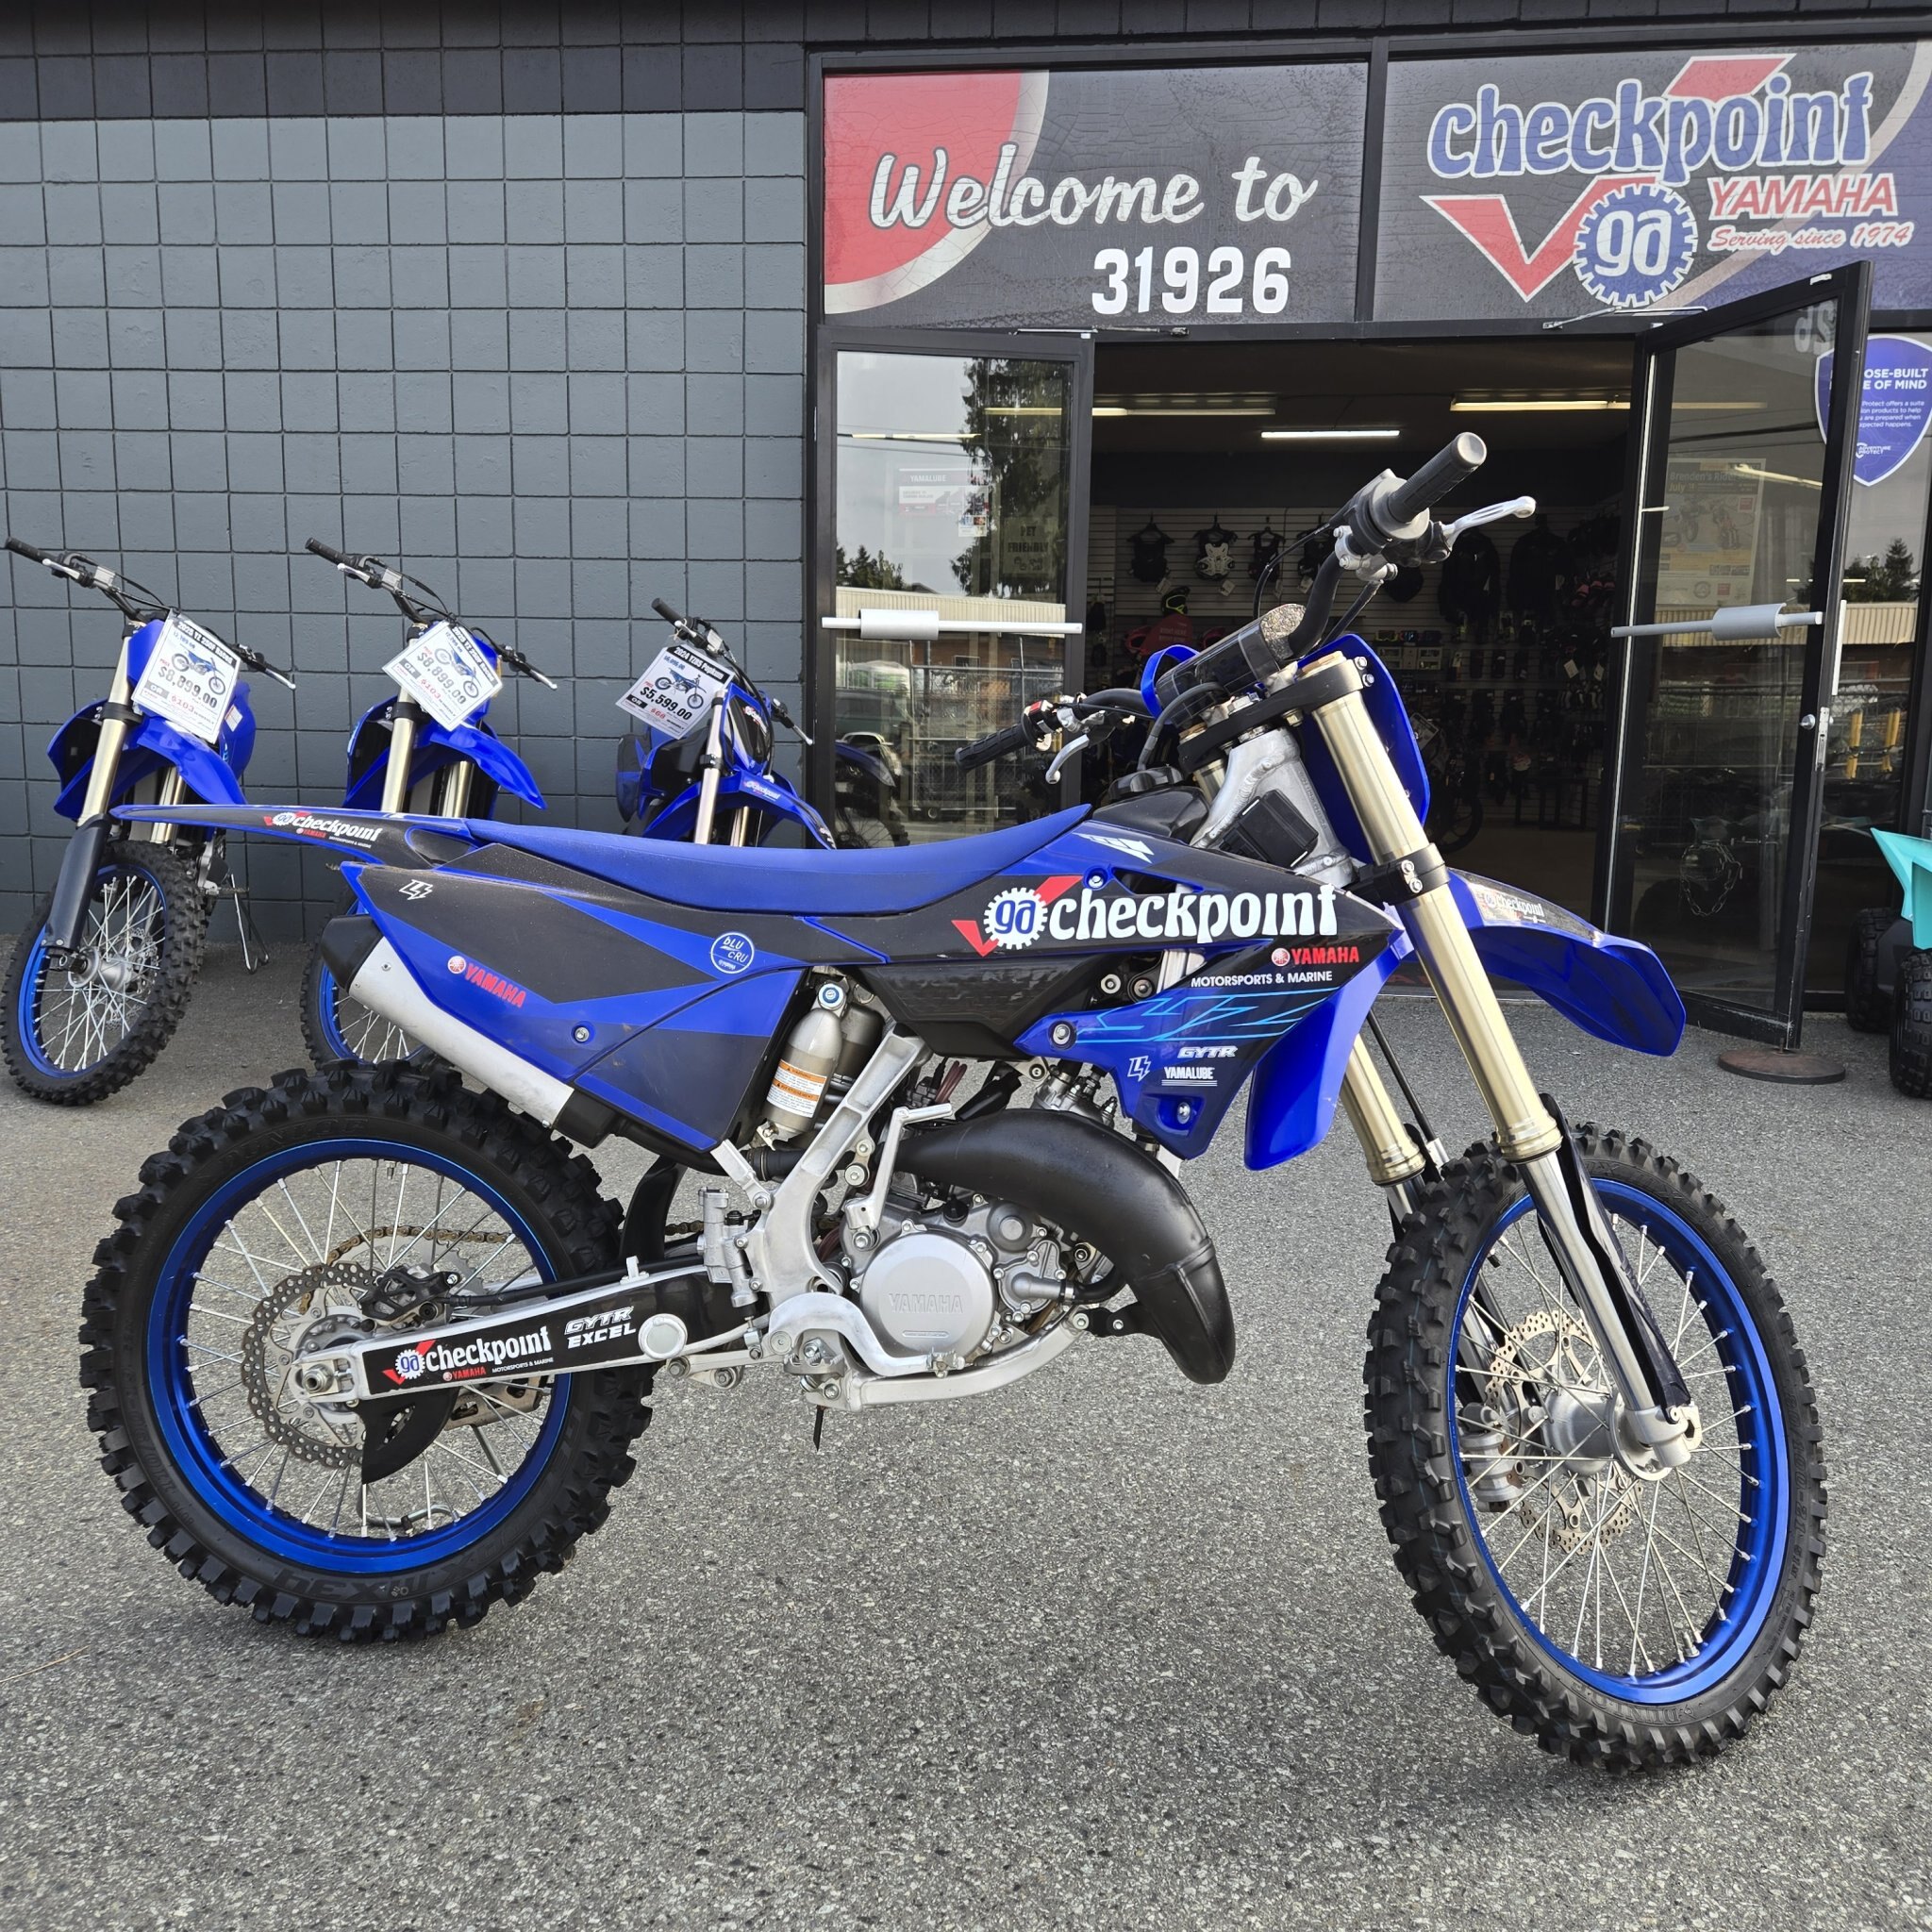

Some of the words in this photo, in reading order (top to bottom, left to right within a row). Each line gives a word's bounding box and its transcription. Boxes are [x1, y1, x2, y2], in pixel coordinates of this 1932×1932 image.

[1427, 73, 1874, 188] checkpoint
[869, 142, 1204, 228] Welcome
[1231, 156, 1318, 223] to
[1707, 173, 1898, 221] YAMAHA
[1708, 226, 1789, 253] Serving
[1793, 228, 1845, 248] since
[1851, 222, 1914, 247] 1974
[1091, 245, 1291, 315] 31926
[1864, 368, 1929, 378] OSE-BUILT
[1874, 380, 1892, 390] OF
[1894, 379, 1927, 390] MIND
[1020, 525, 1037, 537] PET
[1008, 542, 1049, 553] FRIENDLY
[674, 646, 690, 659] 2024
[158, 666, 218, 708] $8,899.00
[417, 652, 467, 705] $8,899.00
[641, 686, 692, 721] $5,599.00
[292, 815, 383, 842] checkpoint
[1049, 882, 1338, 943] checkpoint
[1291, 946, 1359, 965] YAMAHA
[465, 962, 526, 1008] YAMAHA
[1191, 973, 1273, 988] MOTORSPORTS
[1274, 973, 1285, 984] &
[1287, 971, 1333, 983] MARINE
[1177, 1045, 1239, 1058] GYTR
[1163, 1066, 1215, 1080] YAMALUBE
[889, 1292, 963, 1313] YAMAHA
[564, 1306, 635, 1335] GYTR
[425, 1325, 552, 1373] checkpoint
[567, 1323, 637, 1350] EXCEL
[452, 1366, 487, 1380] YAMAHA
